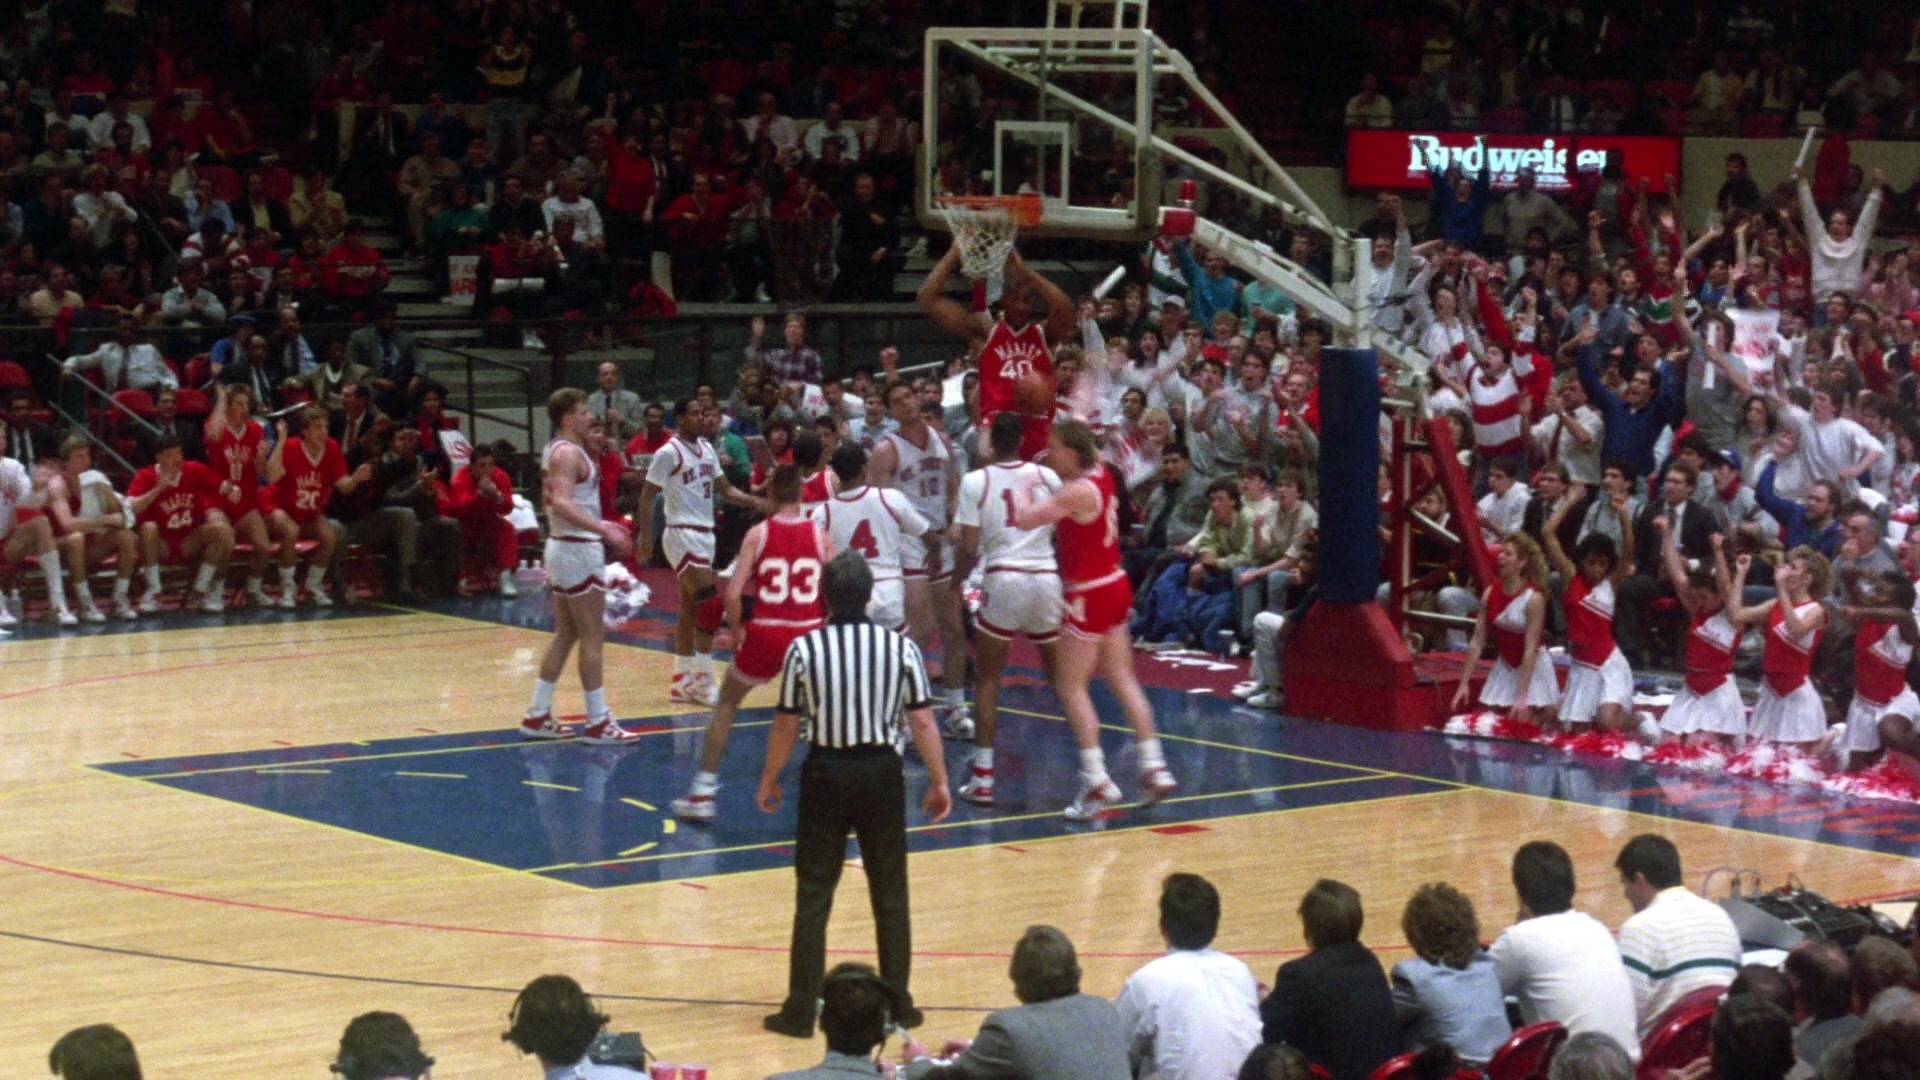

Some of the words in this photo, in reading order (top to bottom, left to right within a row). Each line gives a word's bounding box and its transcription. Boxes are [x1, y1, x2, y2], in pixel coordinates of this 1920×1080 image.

[999, 360, 1034, 379] 40
[702, 481, 712, 500] 3
[166, 509, 194, 530] 44
[849, 518, 880, 559] 4
[759, 557, 822, 604] 33
